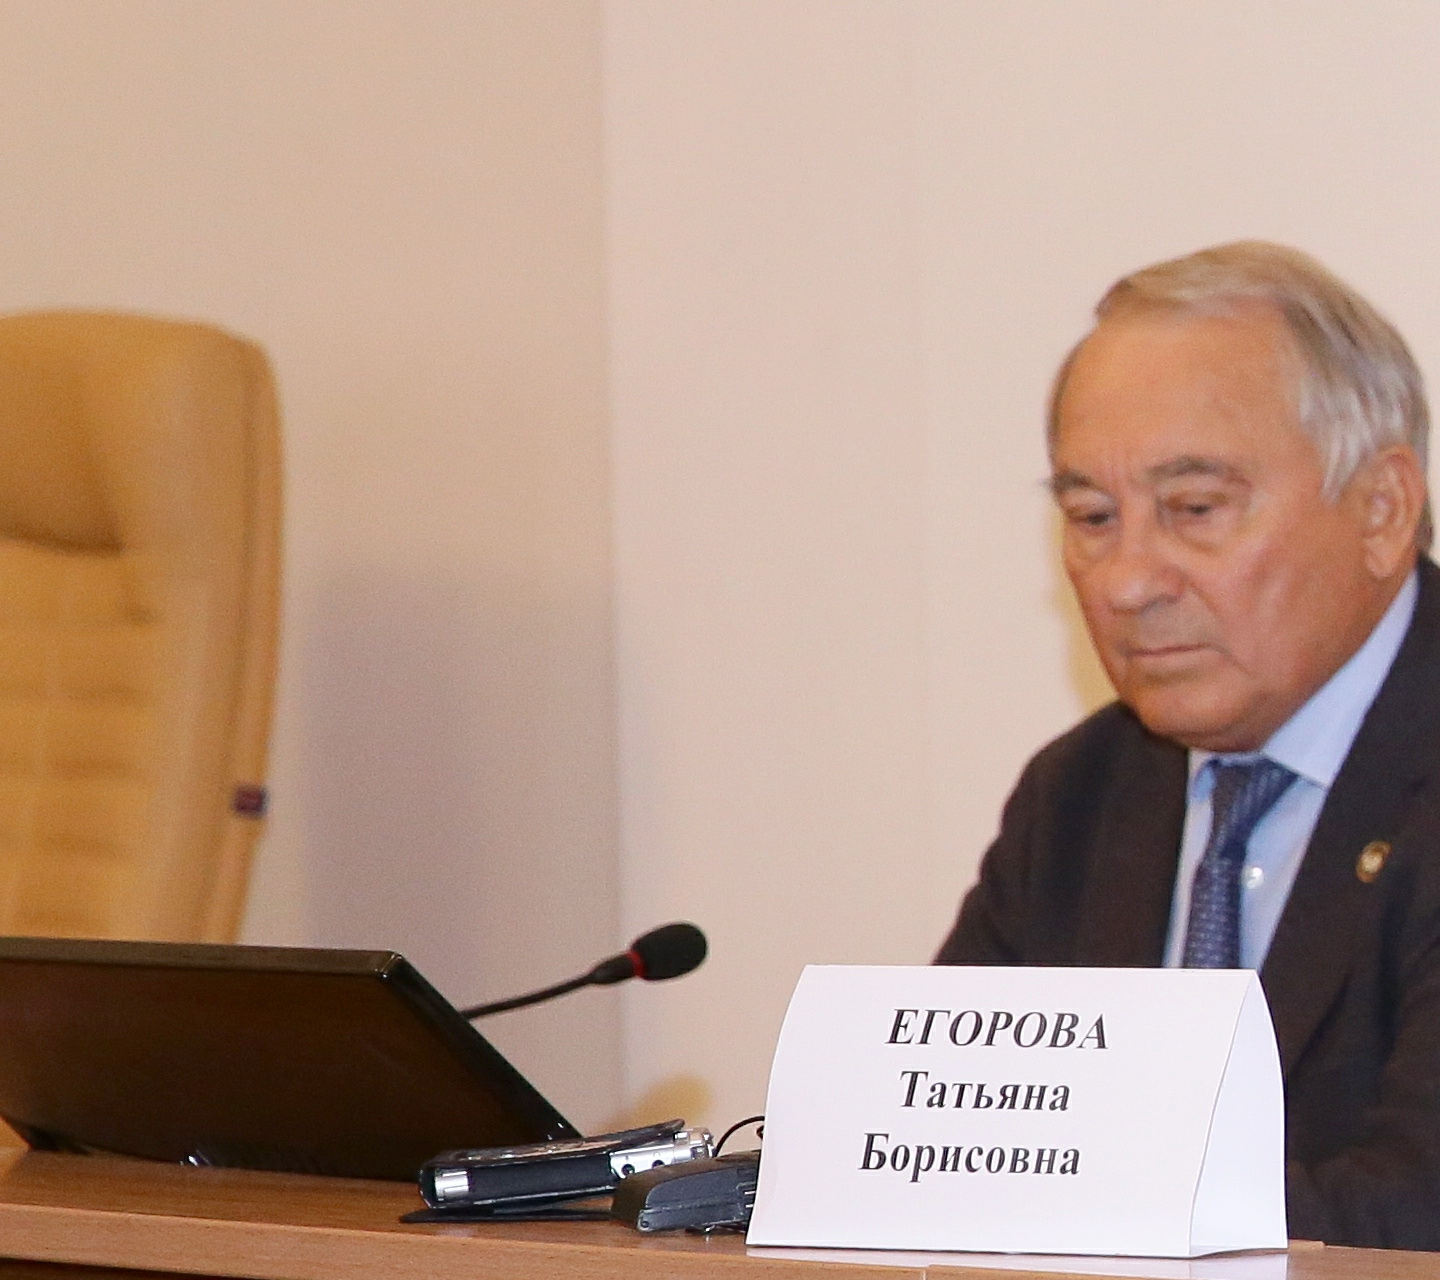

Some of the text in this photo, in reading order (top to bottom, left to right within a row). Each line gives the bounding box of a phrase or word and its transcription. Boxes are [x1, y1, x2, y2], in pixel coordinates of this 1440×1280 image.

[885, 1008, 1108, 1051] ЕГОРОВА
[899, 1069, 1071, 1113] Татьяна
[857, 1131, 1081, 1184] Борисовна
